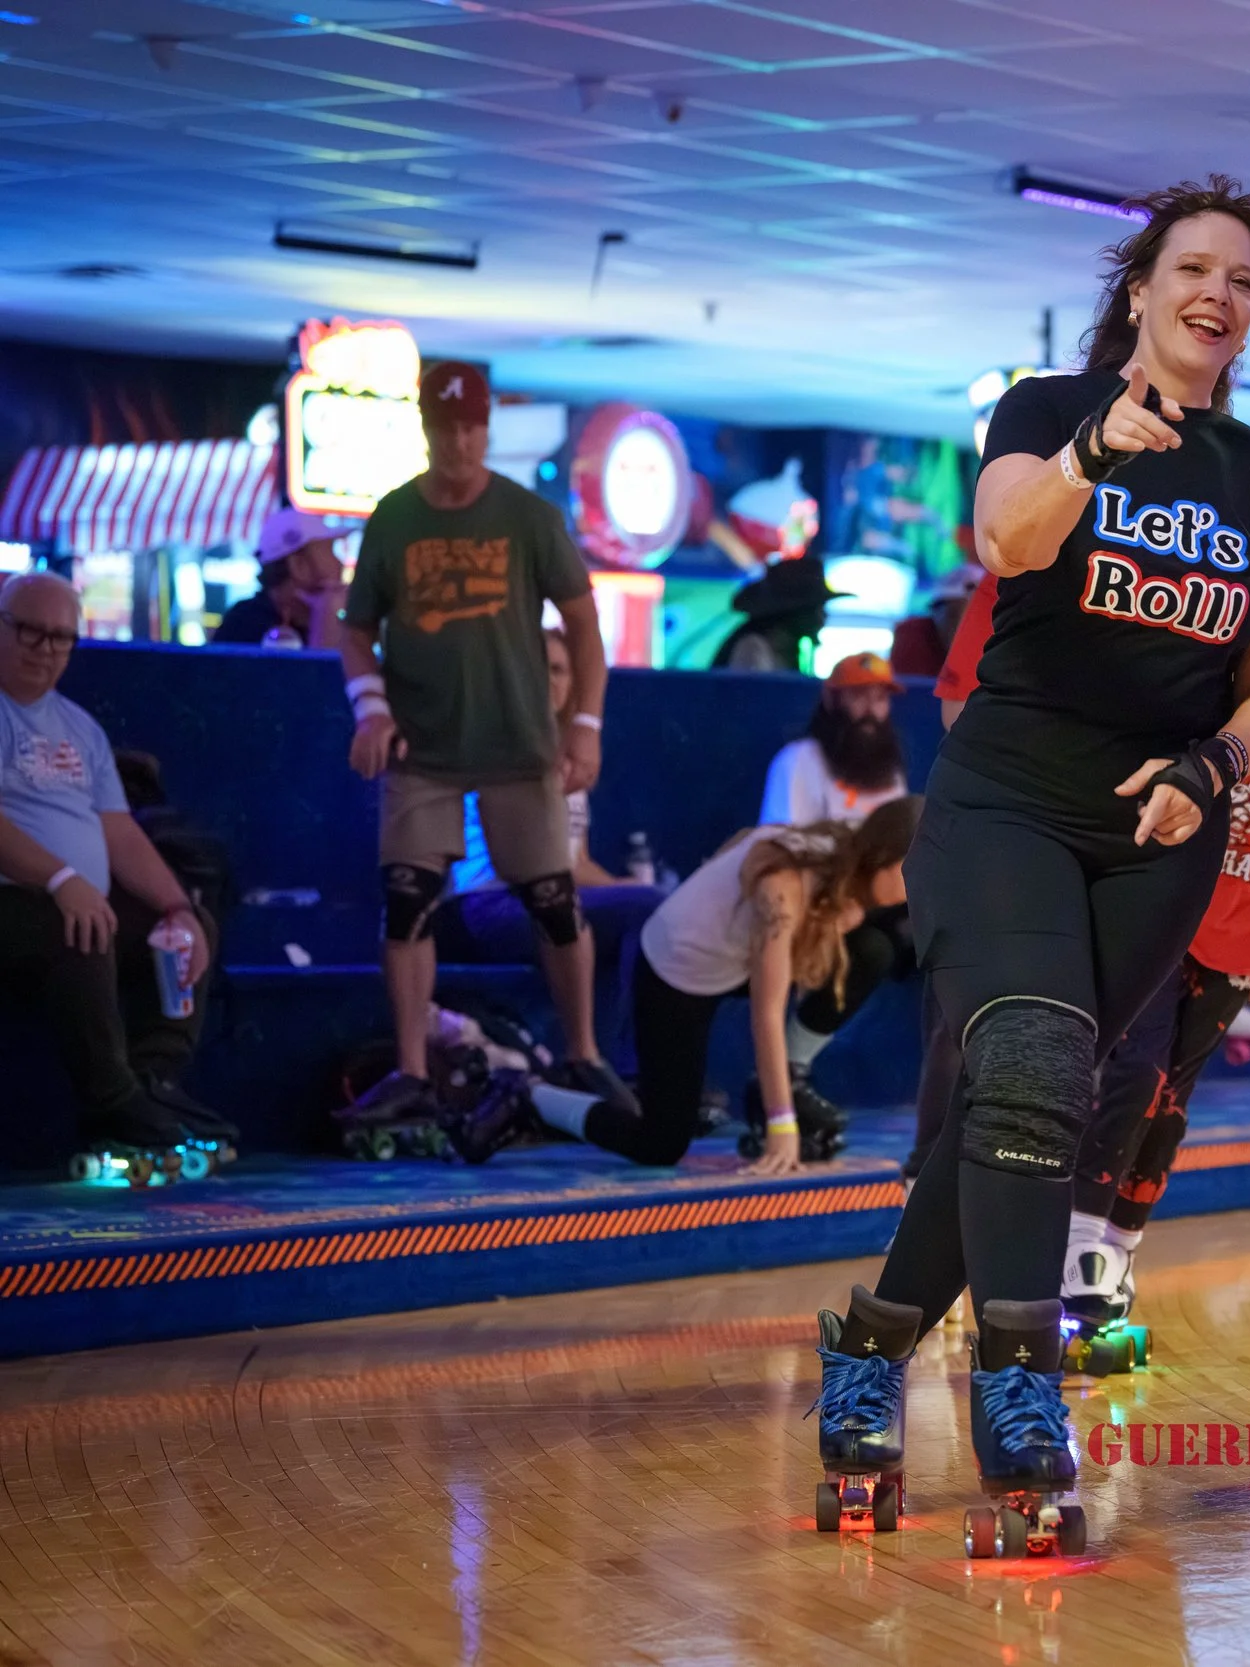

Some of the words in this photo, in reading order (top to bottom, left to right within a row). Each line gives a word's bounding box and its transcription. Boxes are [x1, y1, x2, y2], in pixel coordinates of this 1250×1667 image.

[1096, 485, 1248, 570] Let's
[1082, 553, 1248, 643] Roll!
[1002, 1150, 1061, 1168] MUELLER
